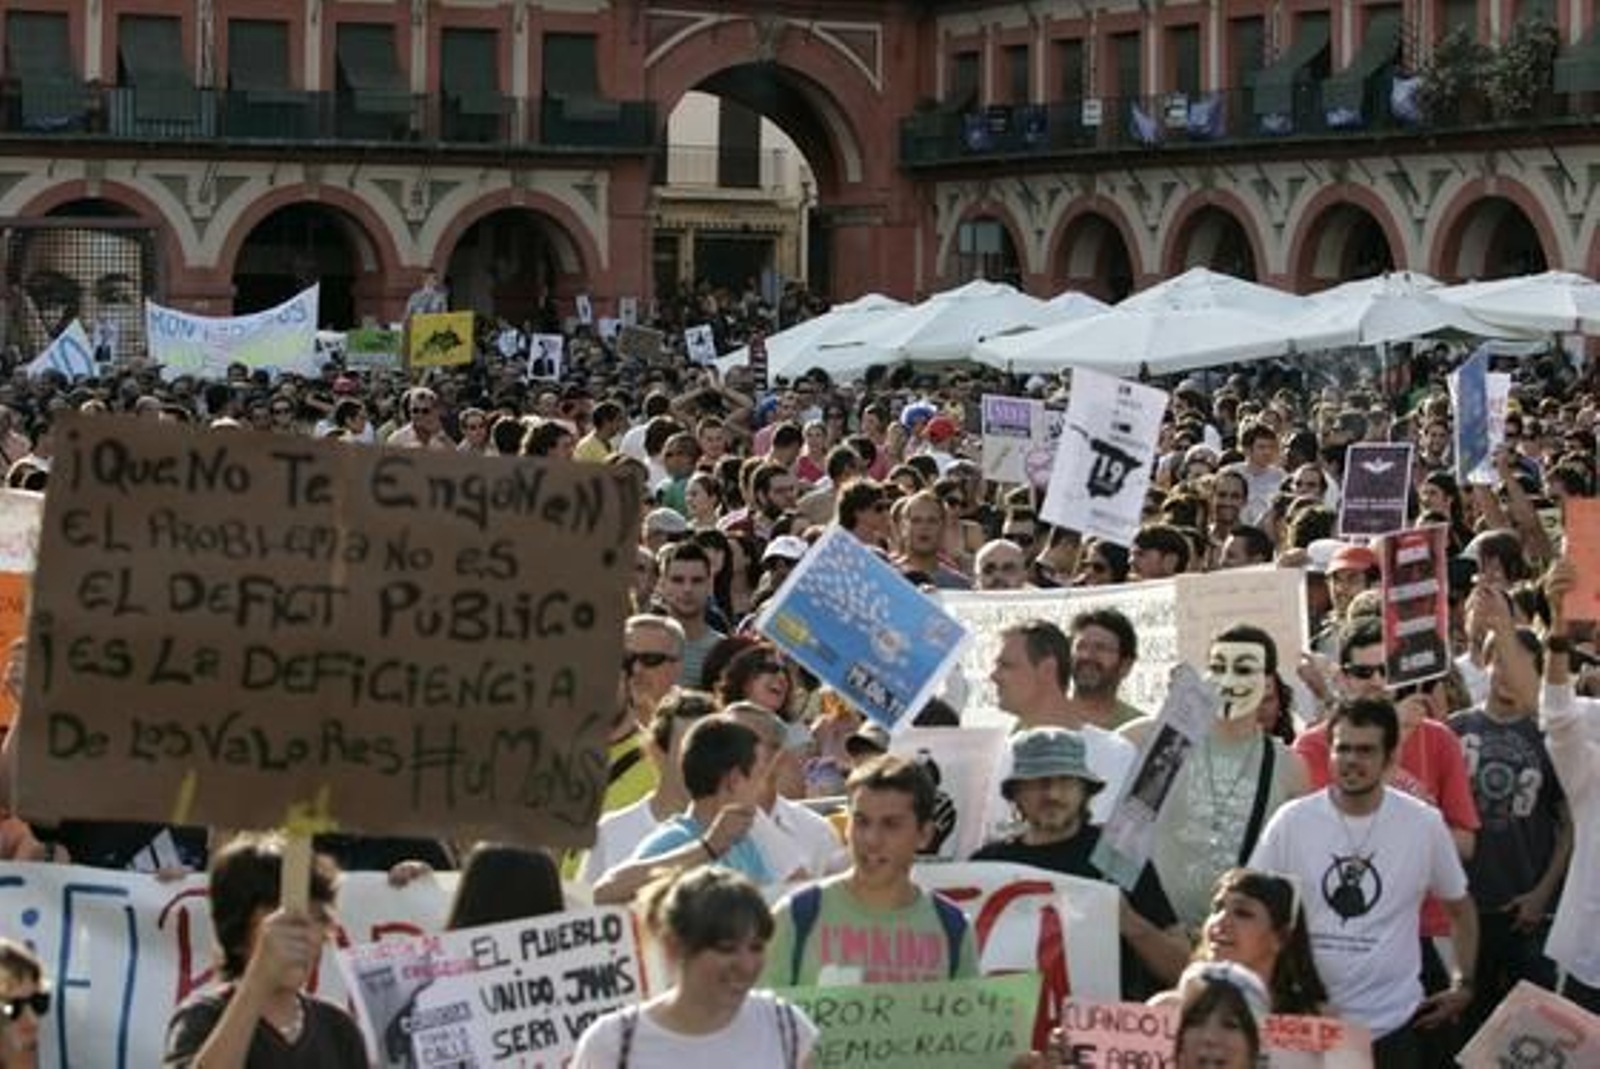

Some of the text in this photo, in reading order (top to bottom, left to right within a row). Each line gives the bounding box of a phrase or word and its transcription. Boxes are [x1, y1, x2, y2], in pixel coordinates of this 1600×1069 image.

[61, 506, 132, 552] EL
[76, 569, 148, 618] EL
[470, 935, 511, 971] EL
